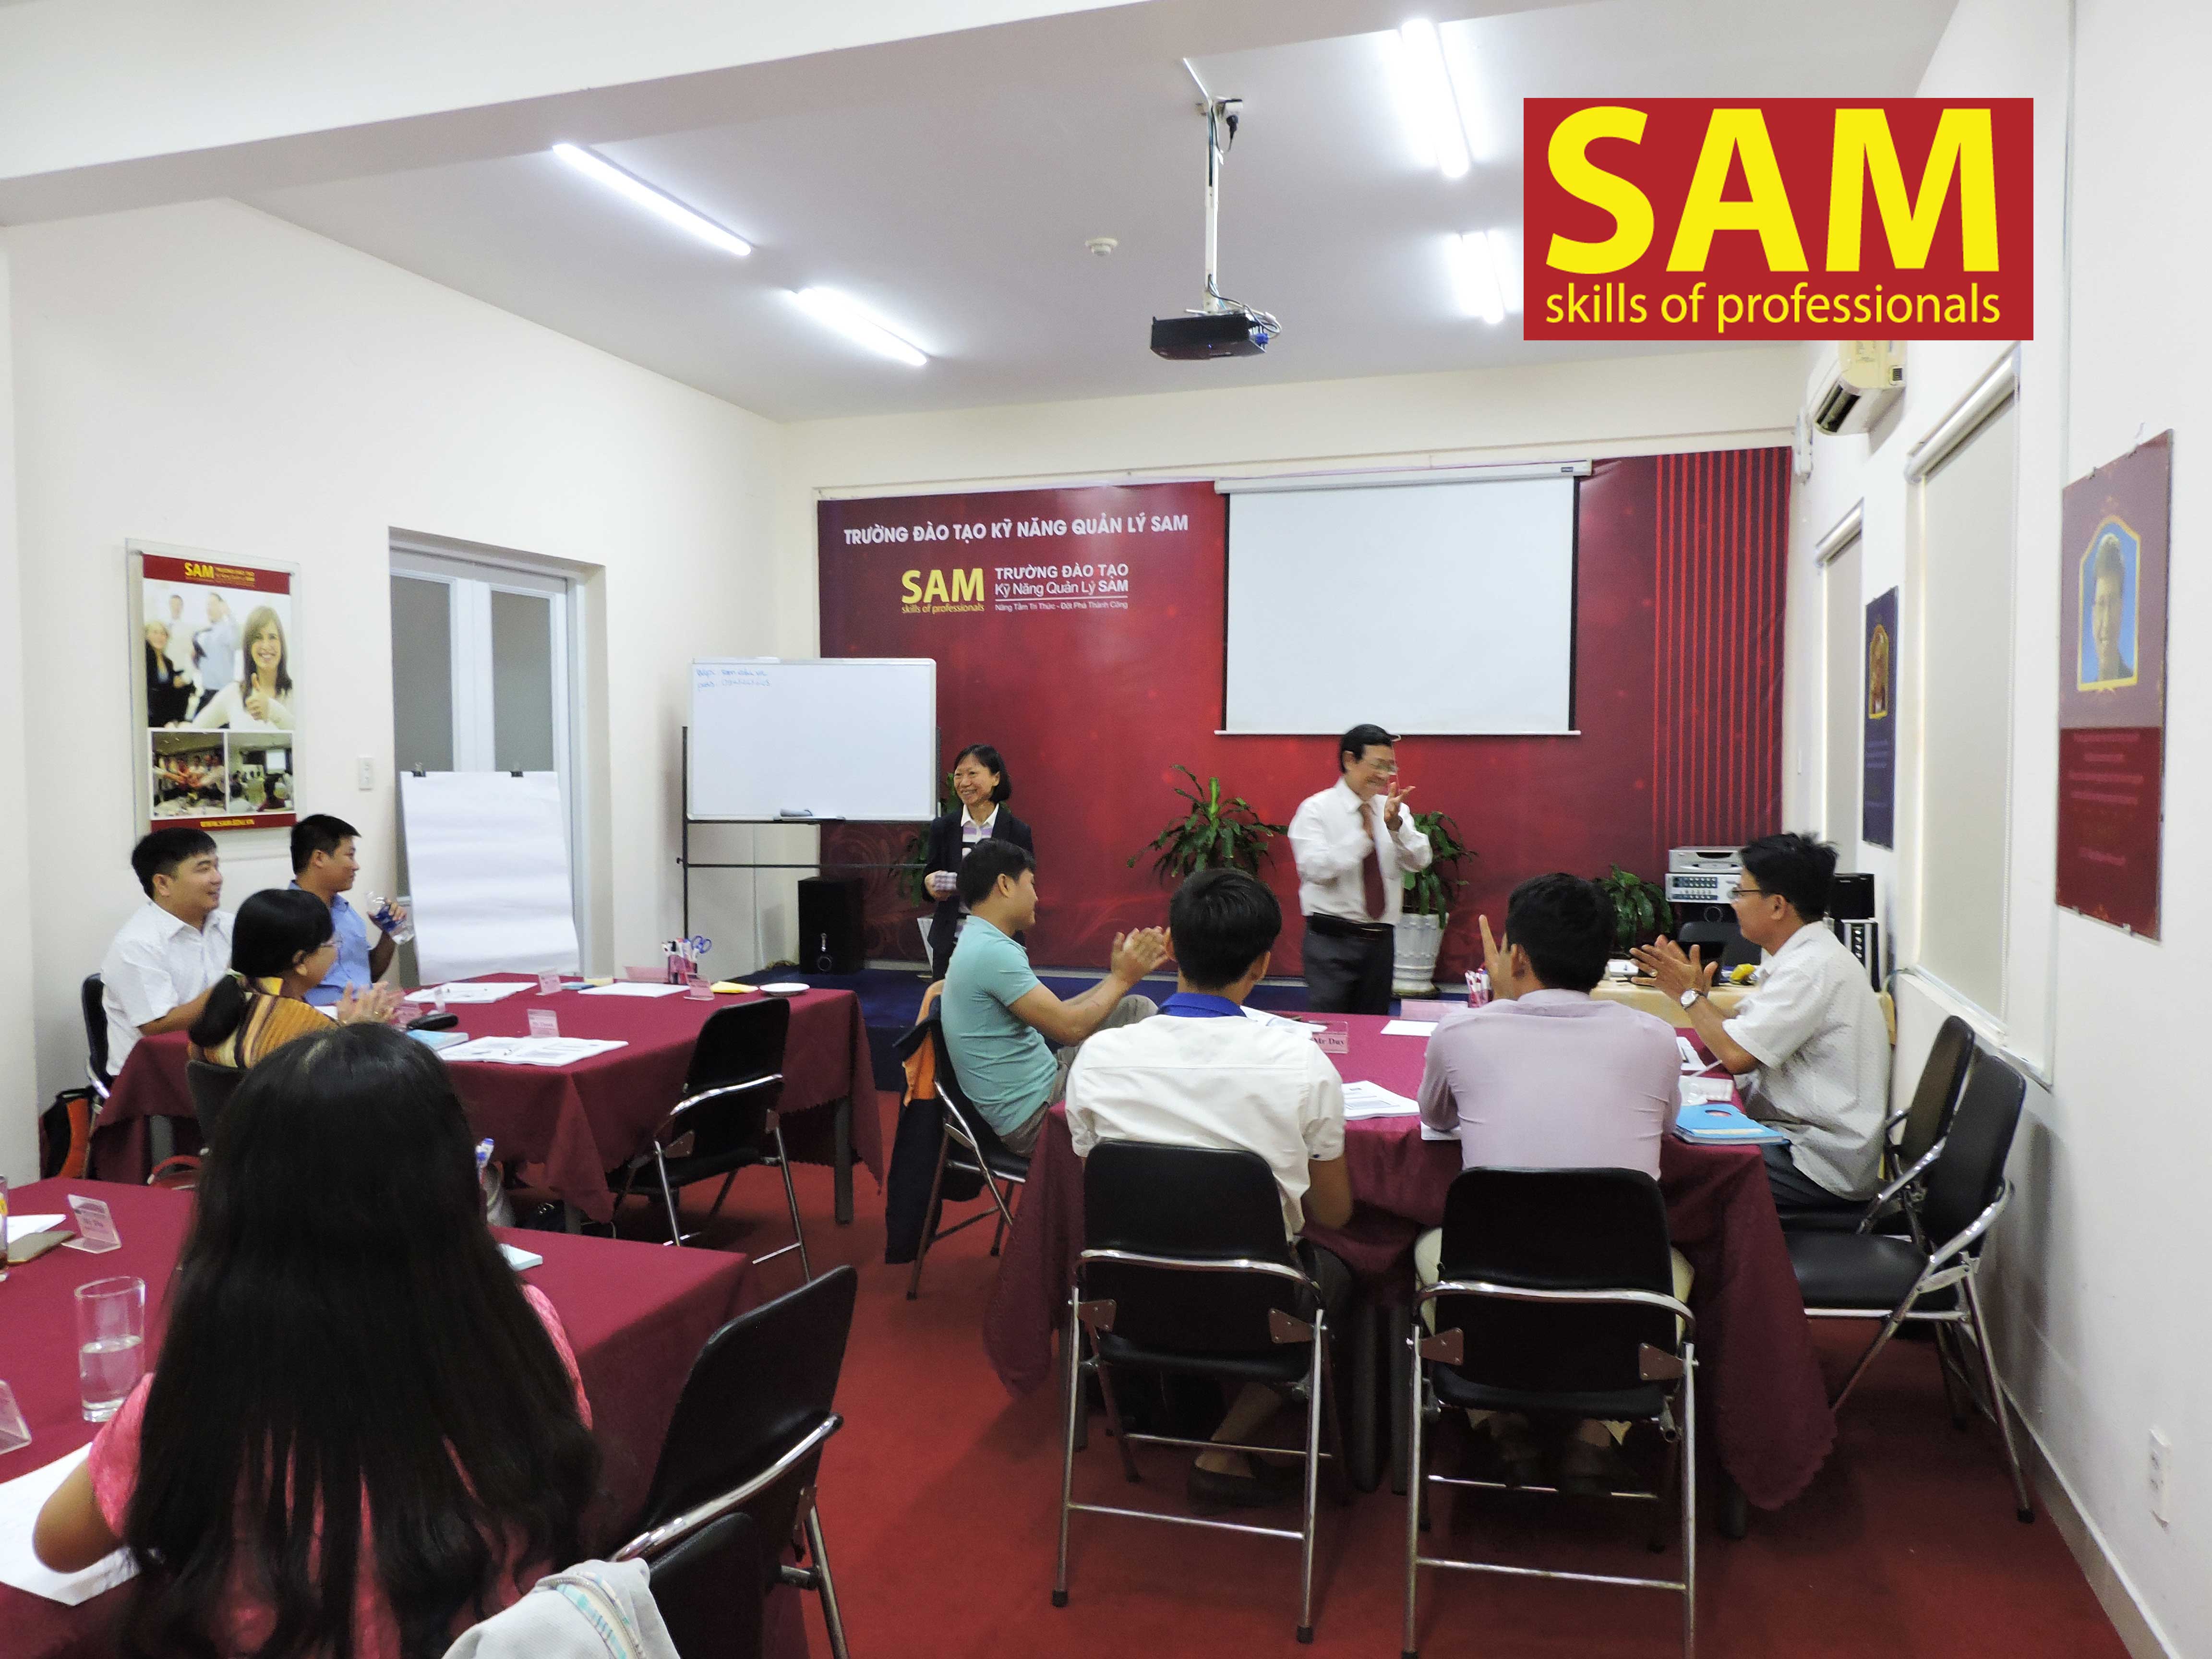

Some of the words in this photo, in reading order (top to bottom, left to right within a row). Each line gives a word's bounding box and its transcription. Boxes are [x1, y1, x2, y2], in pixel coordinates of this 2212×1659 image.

[844, 523, 909, 544] TRƯỜNG
[913, 521, 950, 541] ĐÀO
[953, 523, 986, 544] TẠO
[991, 518, 1012, 539] KỸ
[1017, 517, 1067, 537] NĂNG
[1072, 512, 1122, 535] QUẢN
[1128, 512, 1146, 533] LÝ
[1151, 514, 1189, 531] SAM
[184, 562, 214, 578] SAM
[995, 564, 1058, 580] TRƯỜNG
[1061, 563, 1094, 577] ĐÀO
[1098, 563, 1129, 579] TẠO
[902, 568, 984, 604] SAM
